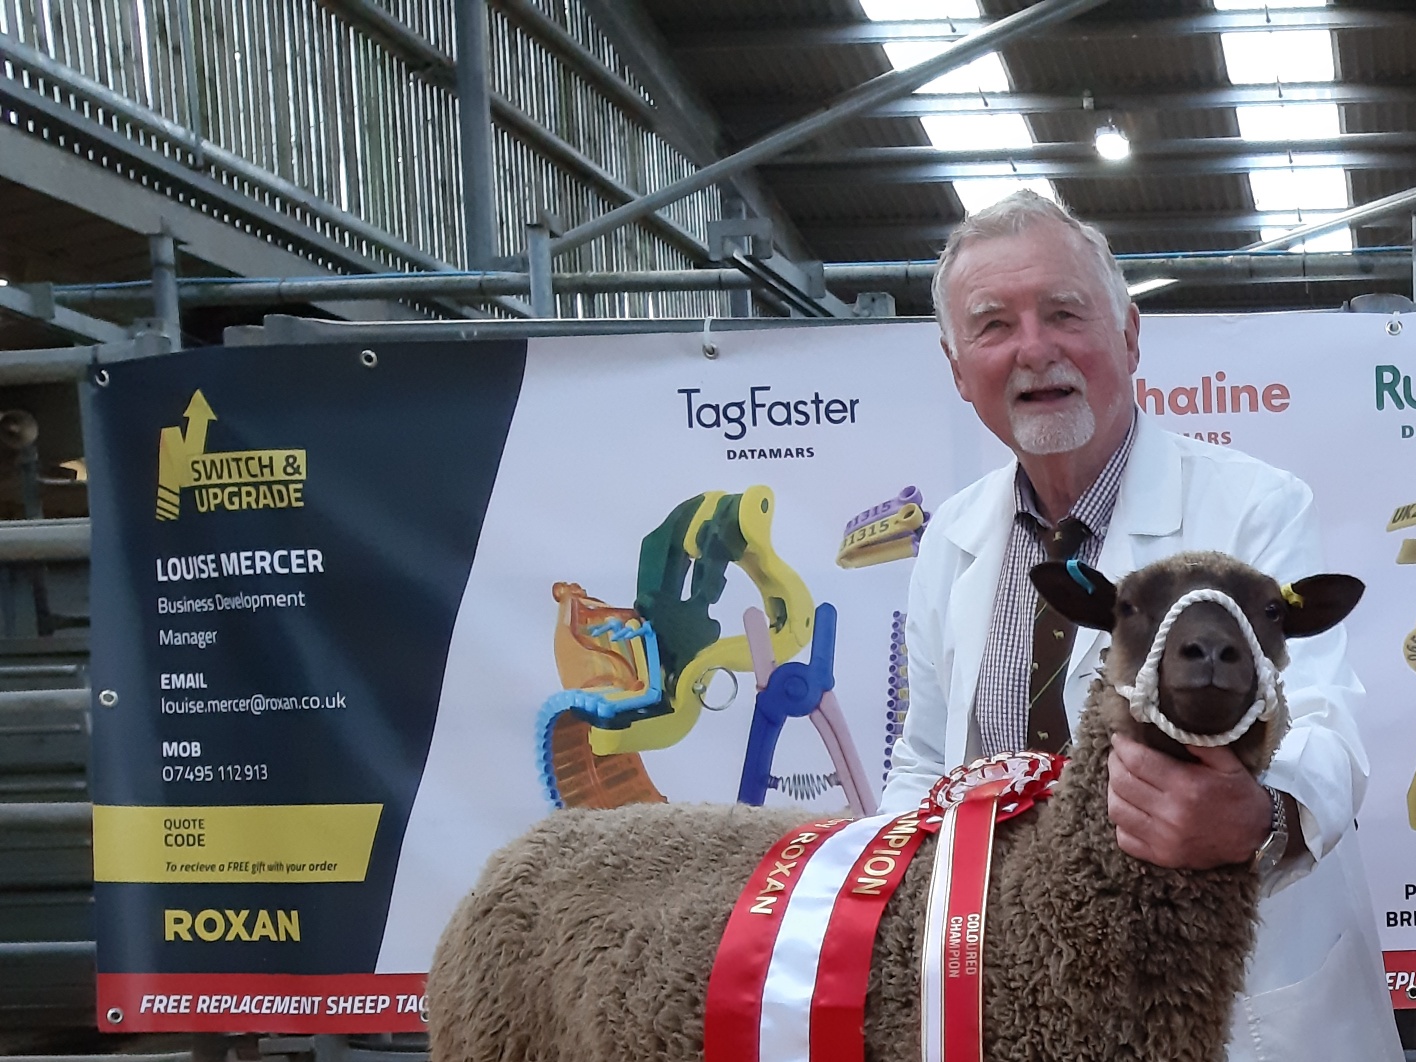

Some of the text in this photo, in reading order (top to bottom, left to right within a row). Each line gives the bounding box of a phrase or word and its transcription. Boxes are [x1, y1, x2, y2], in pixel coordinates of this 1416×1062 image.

[1136, 371, 1291, 416] haline
[677, 385, 860, 440] TagFaster
[726, 447, 815, 461] DATAMARS
[190, 454, 302, 482] SWITCH &
[194, 483, 305, 513] UPGRADE
[156, 549, 325, 582] LOUISE MERCER
[158, 590, 306, 614] Business Development
[159, 629, 218, 649] Manager
[160, 672, 208, 690] EMAIL
[161, 692, 347, 715] louise.mercer@roxan.co.uk
[162, 741, 201, 758] MOB
[162, 764, 268, 782] 07495 112 913
[163, 818, 205, 831] QUOTE
[164, 833, 206, 847] CODE
[166, 860, 338, 875] To recieve a FREE gift with your order
[749, 832, 819, 915] ROXAN
[164, 909, 300, 942] ROXAN
[948, 915, 964, 979] CHAMPION
[965, 912, 981, 976] COLOURED
[139, 995, 193, 1014] FREE
[197, 995, 323, 1015] REPLACEMENT
[326, 996, 389, 1015] SHEEP
